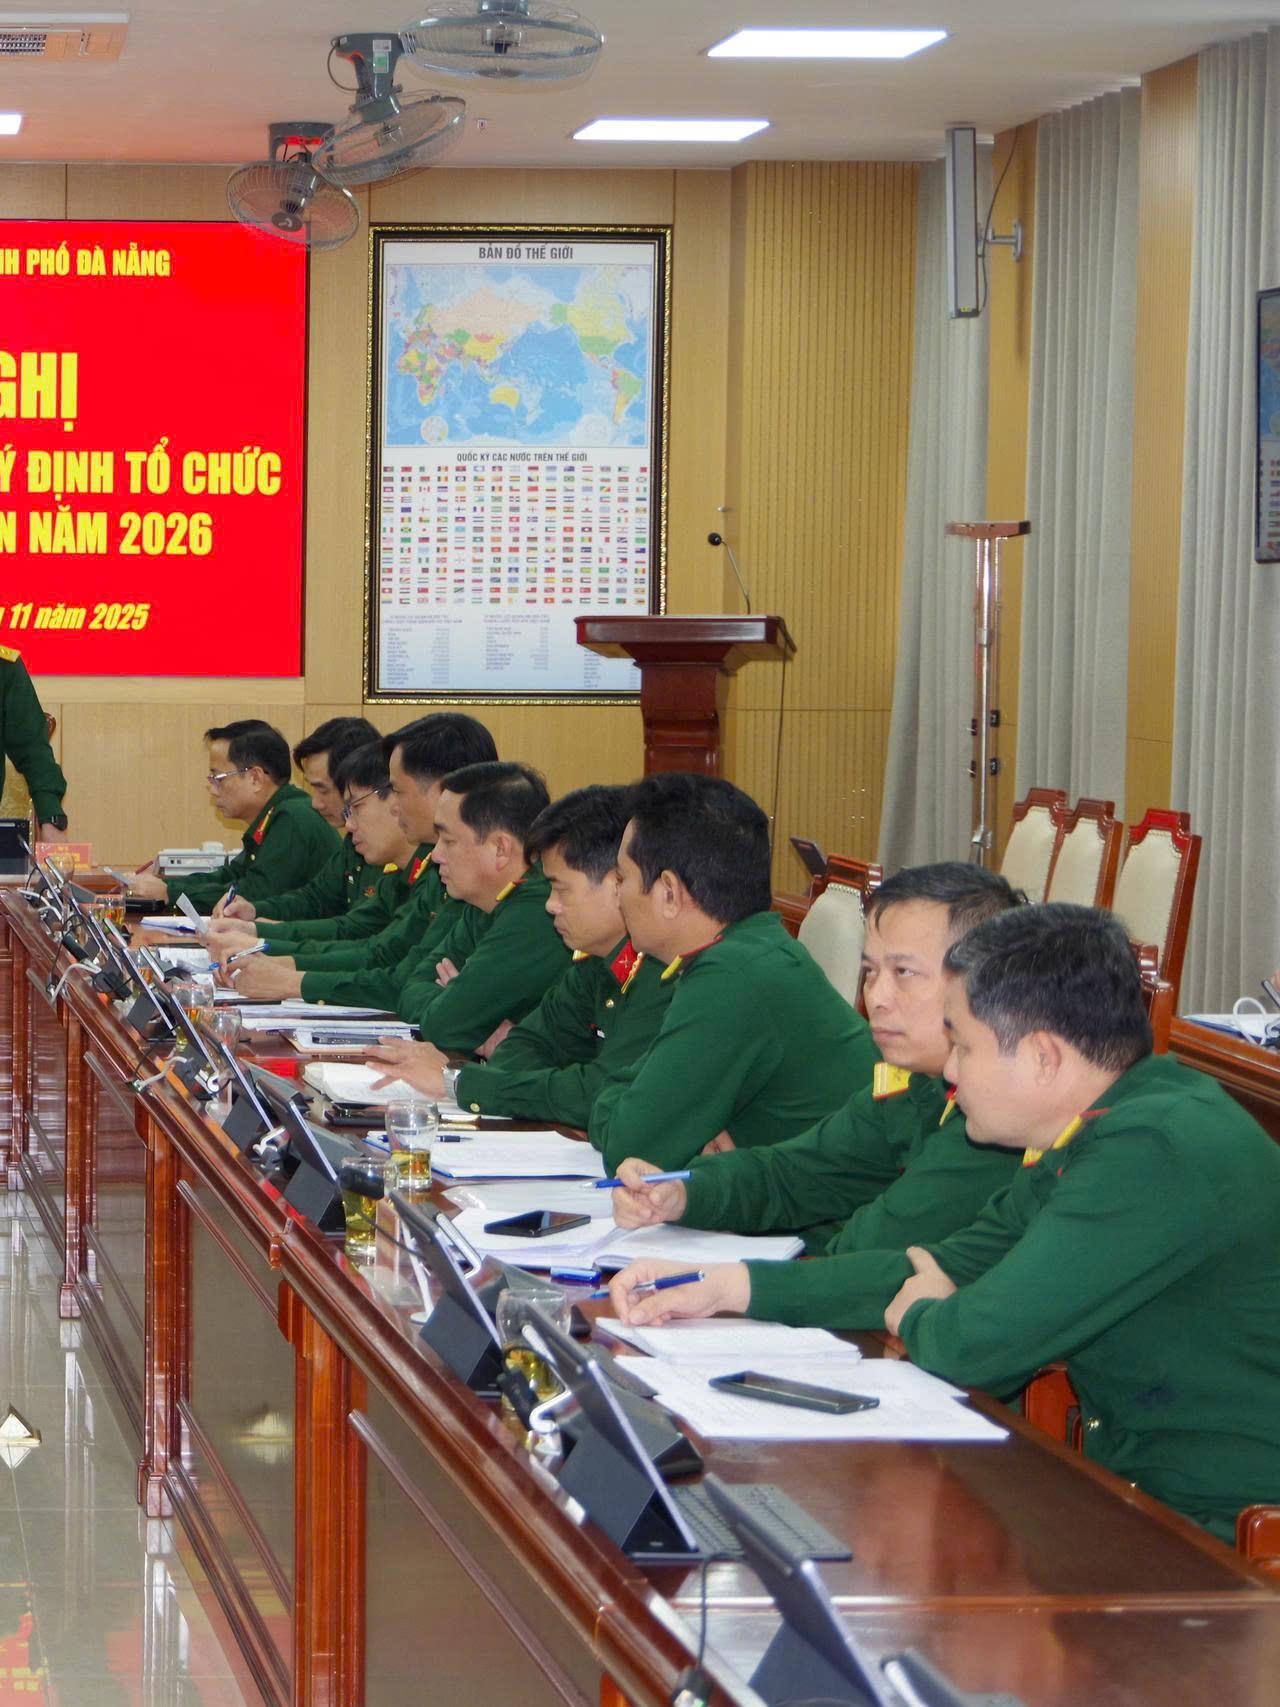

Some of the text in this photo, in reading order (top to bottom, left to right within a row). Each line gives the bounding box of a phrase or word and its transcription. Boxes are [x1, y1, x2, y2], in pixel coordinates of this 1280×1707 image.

[27, 241, 69, 275] PHỐ
[77, 246, 106, 275] ĐÀ
[113, 243, 170, 276] NẴNG
[27, 451, 113, 501] ĐỊNH
[125, 437, 170, 494] TỔ
[183, 446, 281, 495] CHỨC
[30, 505, 107, 553] NĂM
[120, 512, 212, 555] 2026
[10, 603, 35, 628] 11
[34, 603, 86, 629] năm
[89, 603, 150, 630] 2025
